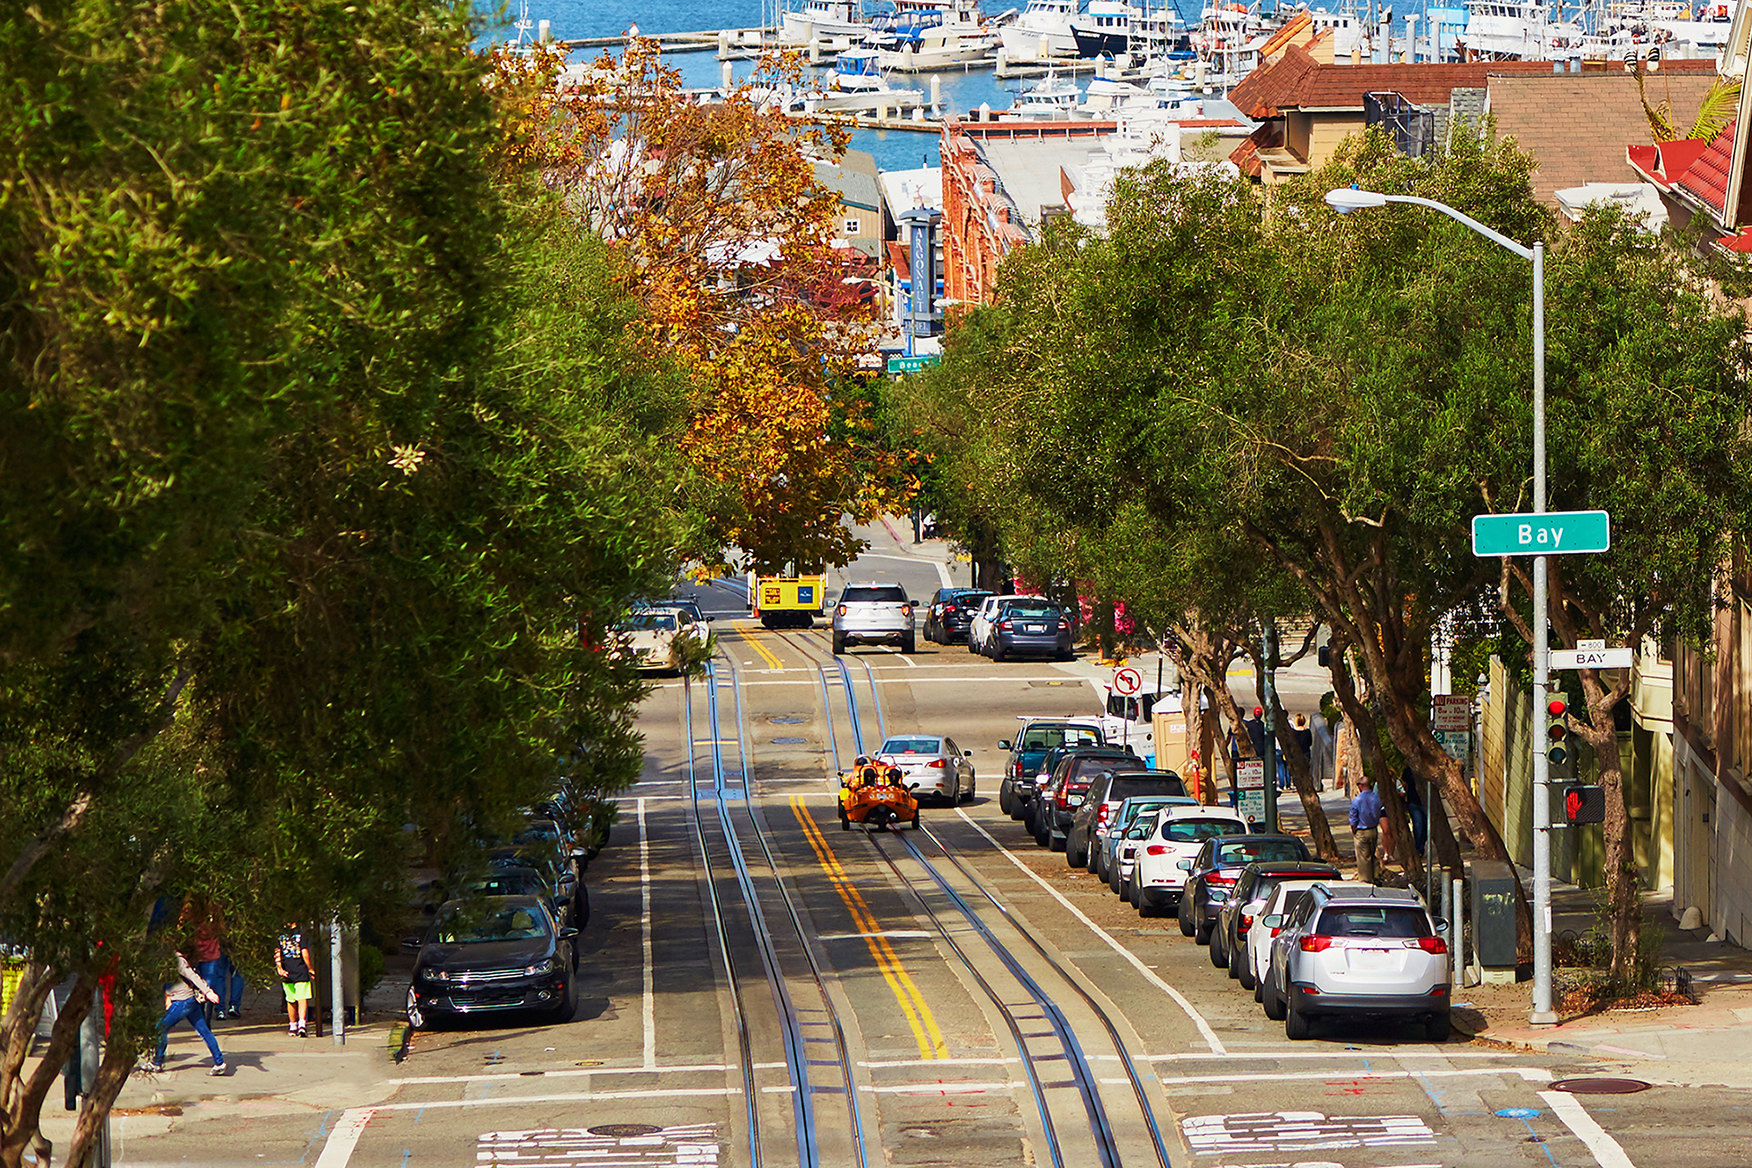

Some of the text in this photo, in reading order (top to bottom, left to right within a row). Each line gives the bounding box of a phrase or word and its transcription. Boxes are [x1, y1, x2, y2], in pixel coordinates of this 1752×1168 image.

[915, 227, 925, 313] ARGONAUT
[1518, 524, 1564, 548] Bay
[1576, 653, 1606, 664] BAY
[1446, 697, 1467, 705] PARKING
